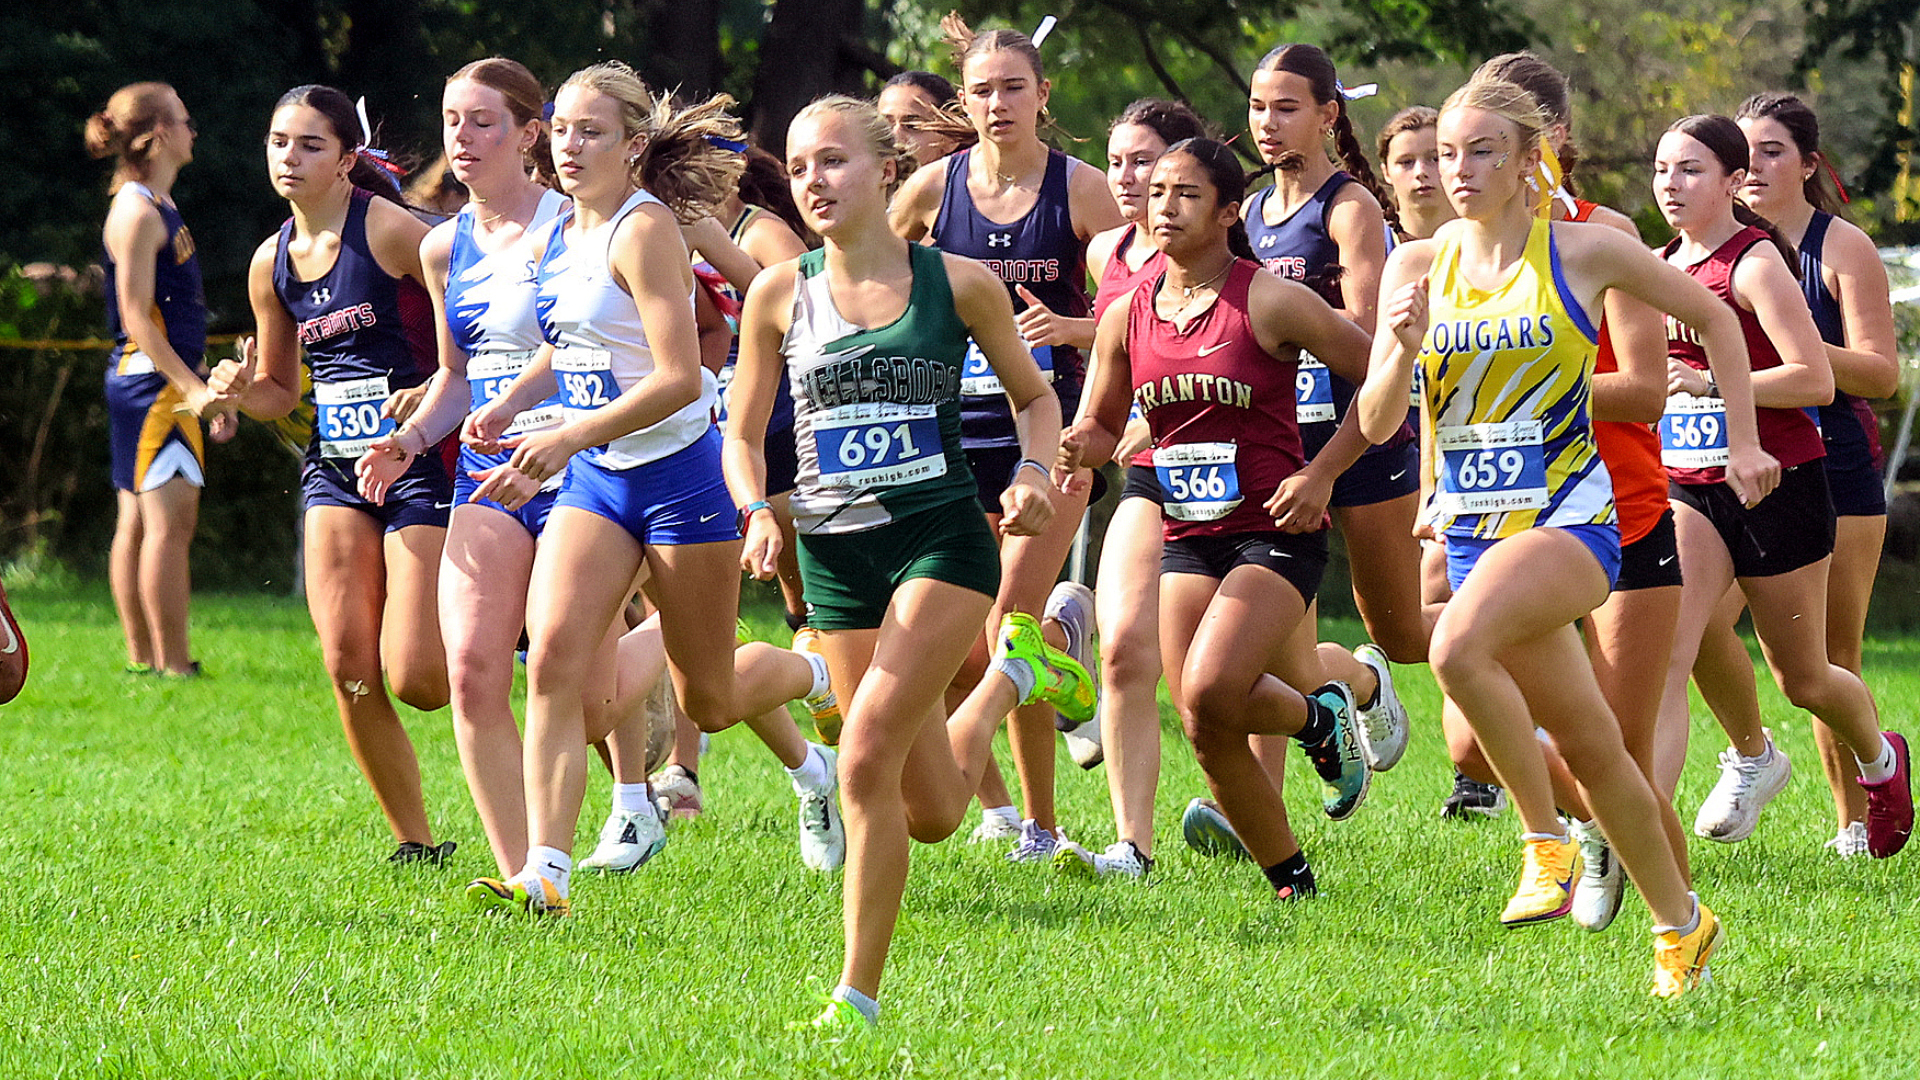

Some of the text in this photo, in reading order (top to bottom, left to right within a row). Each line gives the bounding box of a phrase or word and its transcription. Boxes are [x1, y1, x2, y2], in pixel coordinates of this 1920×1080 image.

[981, 258, 1060, 282] RIOTS
[297, 302, 377, 345] ATRIOTS
[1421, 314, 1554, 355] OUGARS
[562, 372, 611, 407] 582
[325, 403, 380, 438] 530
[1670, 414, 1720, 448] 569
[837, 422, 921, 468] 691
[1168, 466, 1227, 500] 566
[1458, 449, 1524, 489] 659
[1337, 707, 1361, 761] HOKA
